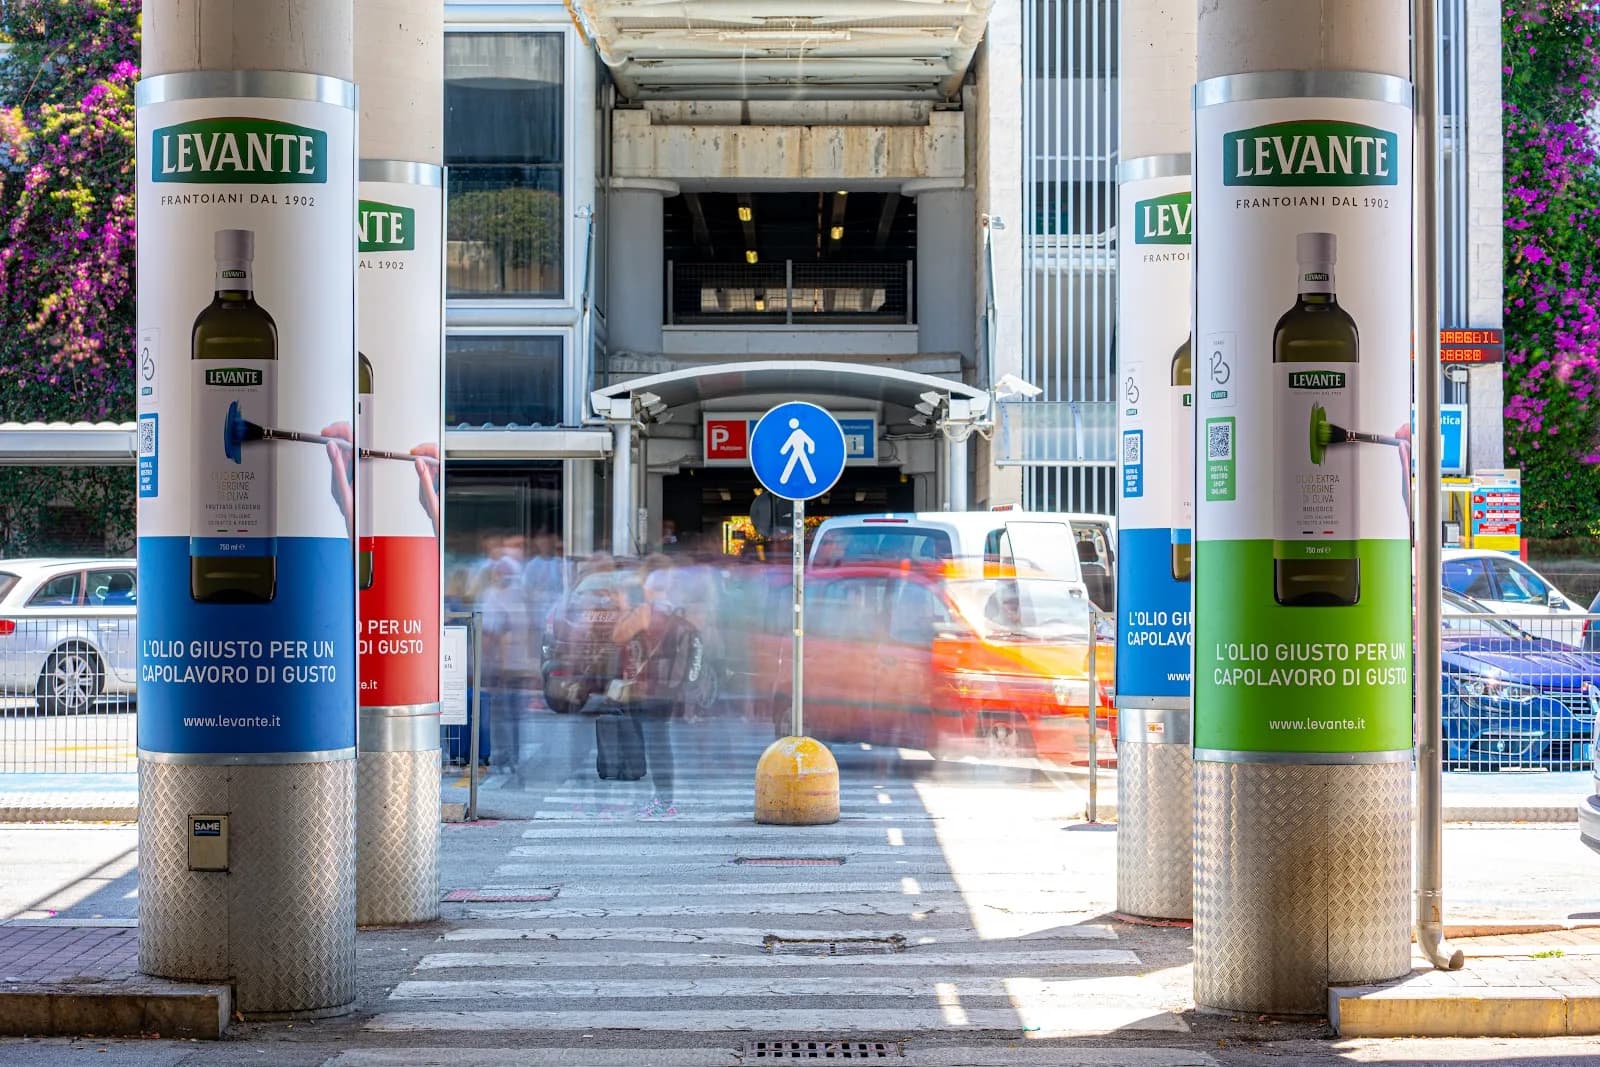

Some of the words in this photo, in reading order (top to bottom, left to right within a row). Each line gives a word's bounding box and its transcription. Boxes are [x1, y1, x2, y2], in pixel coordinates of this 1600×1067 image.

[161, 132, 316, 175] LEVANTE
[1235, 135, 1389, 178] LEVANTE
[161, 193, 243, 207] FRANTOIANI
[250, 193, 278, 205] DAL
[285, 195, 316, 207] 1902
[1236, 196, 1325, 209] FRANTOIANI
[1332, 196, 1358, 208] DAL
[1363, 198, 1389, 209] 1902
[1144, 204, 1192, 238] LEV
[378, 261, 405, 270] 1902
[210, 371, 258, 384] LEVANTE
[1293, 373, 1342, 387] LEVANTE
[1440, 415, 1461, 425] tica
[711, 428, 730, 451] P
[230, 471, 255, 481] EXTRA
[1315, 474, 1340, 484] EXTRA
[1129, 611, 1168, 626] L'OLIO
[368, 619, 399, 635] PER
[403, 619, 422, 634] UN
[143, 640, 184, 658] L'OLIO
[190, 640, 263, 659] GIUSTO
[270, 640, 309, 659] PER
[313, 640, 334, 658] UN
[359, 640, 373, 655] DI
[378, 639, 423, 655] GUSTO
[1216, 643, 1269, 662] L'OLIO
[1275, 643, 1349, 662] GIUSTO
[1355, 643, 1388, 661] PER
[1390, 642, 1406, 660] UN
[142, 665, 249, 684] CAPOLAVORO
[256, 665, 276, 684] DI
[282, 665, 337, 683] GUSTO
[1214, 667, 1336, 686] CAPOLAVORO
[1342, 667, 1361, 686] DI
[1366, 667, 1407, 686] GUSTO
[183, 714, 281, 728] www.levante.it
[1269, 717, 1366, 731] www.levante.it
[194, 822, 220, 831] SAME
